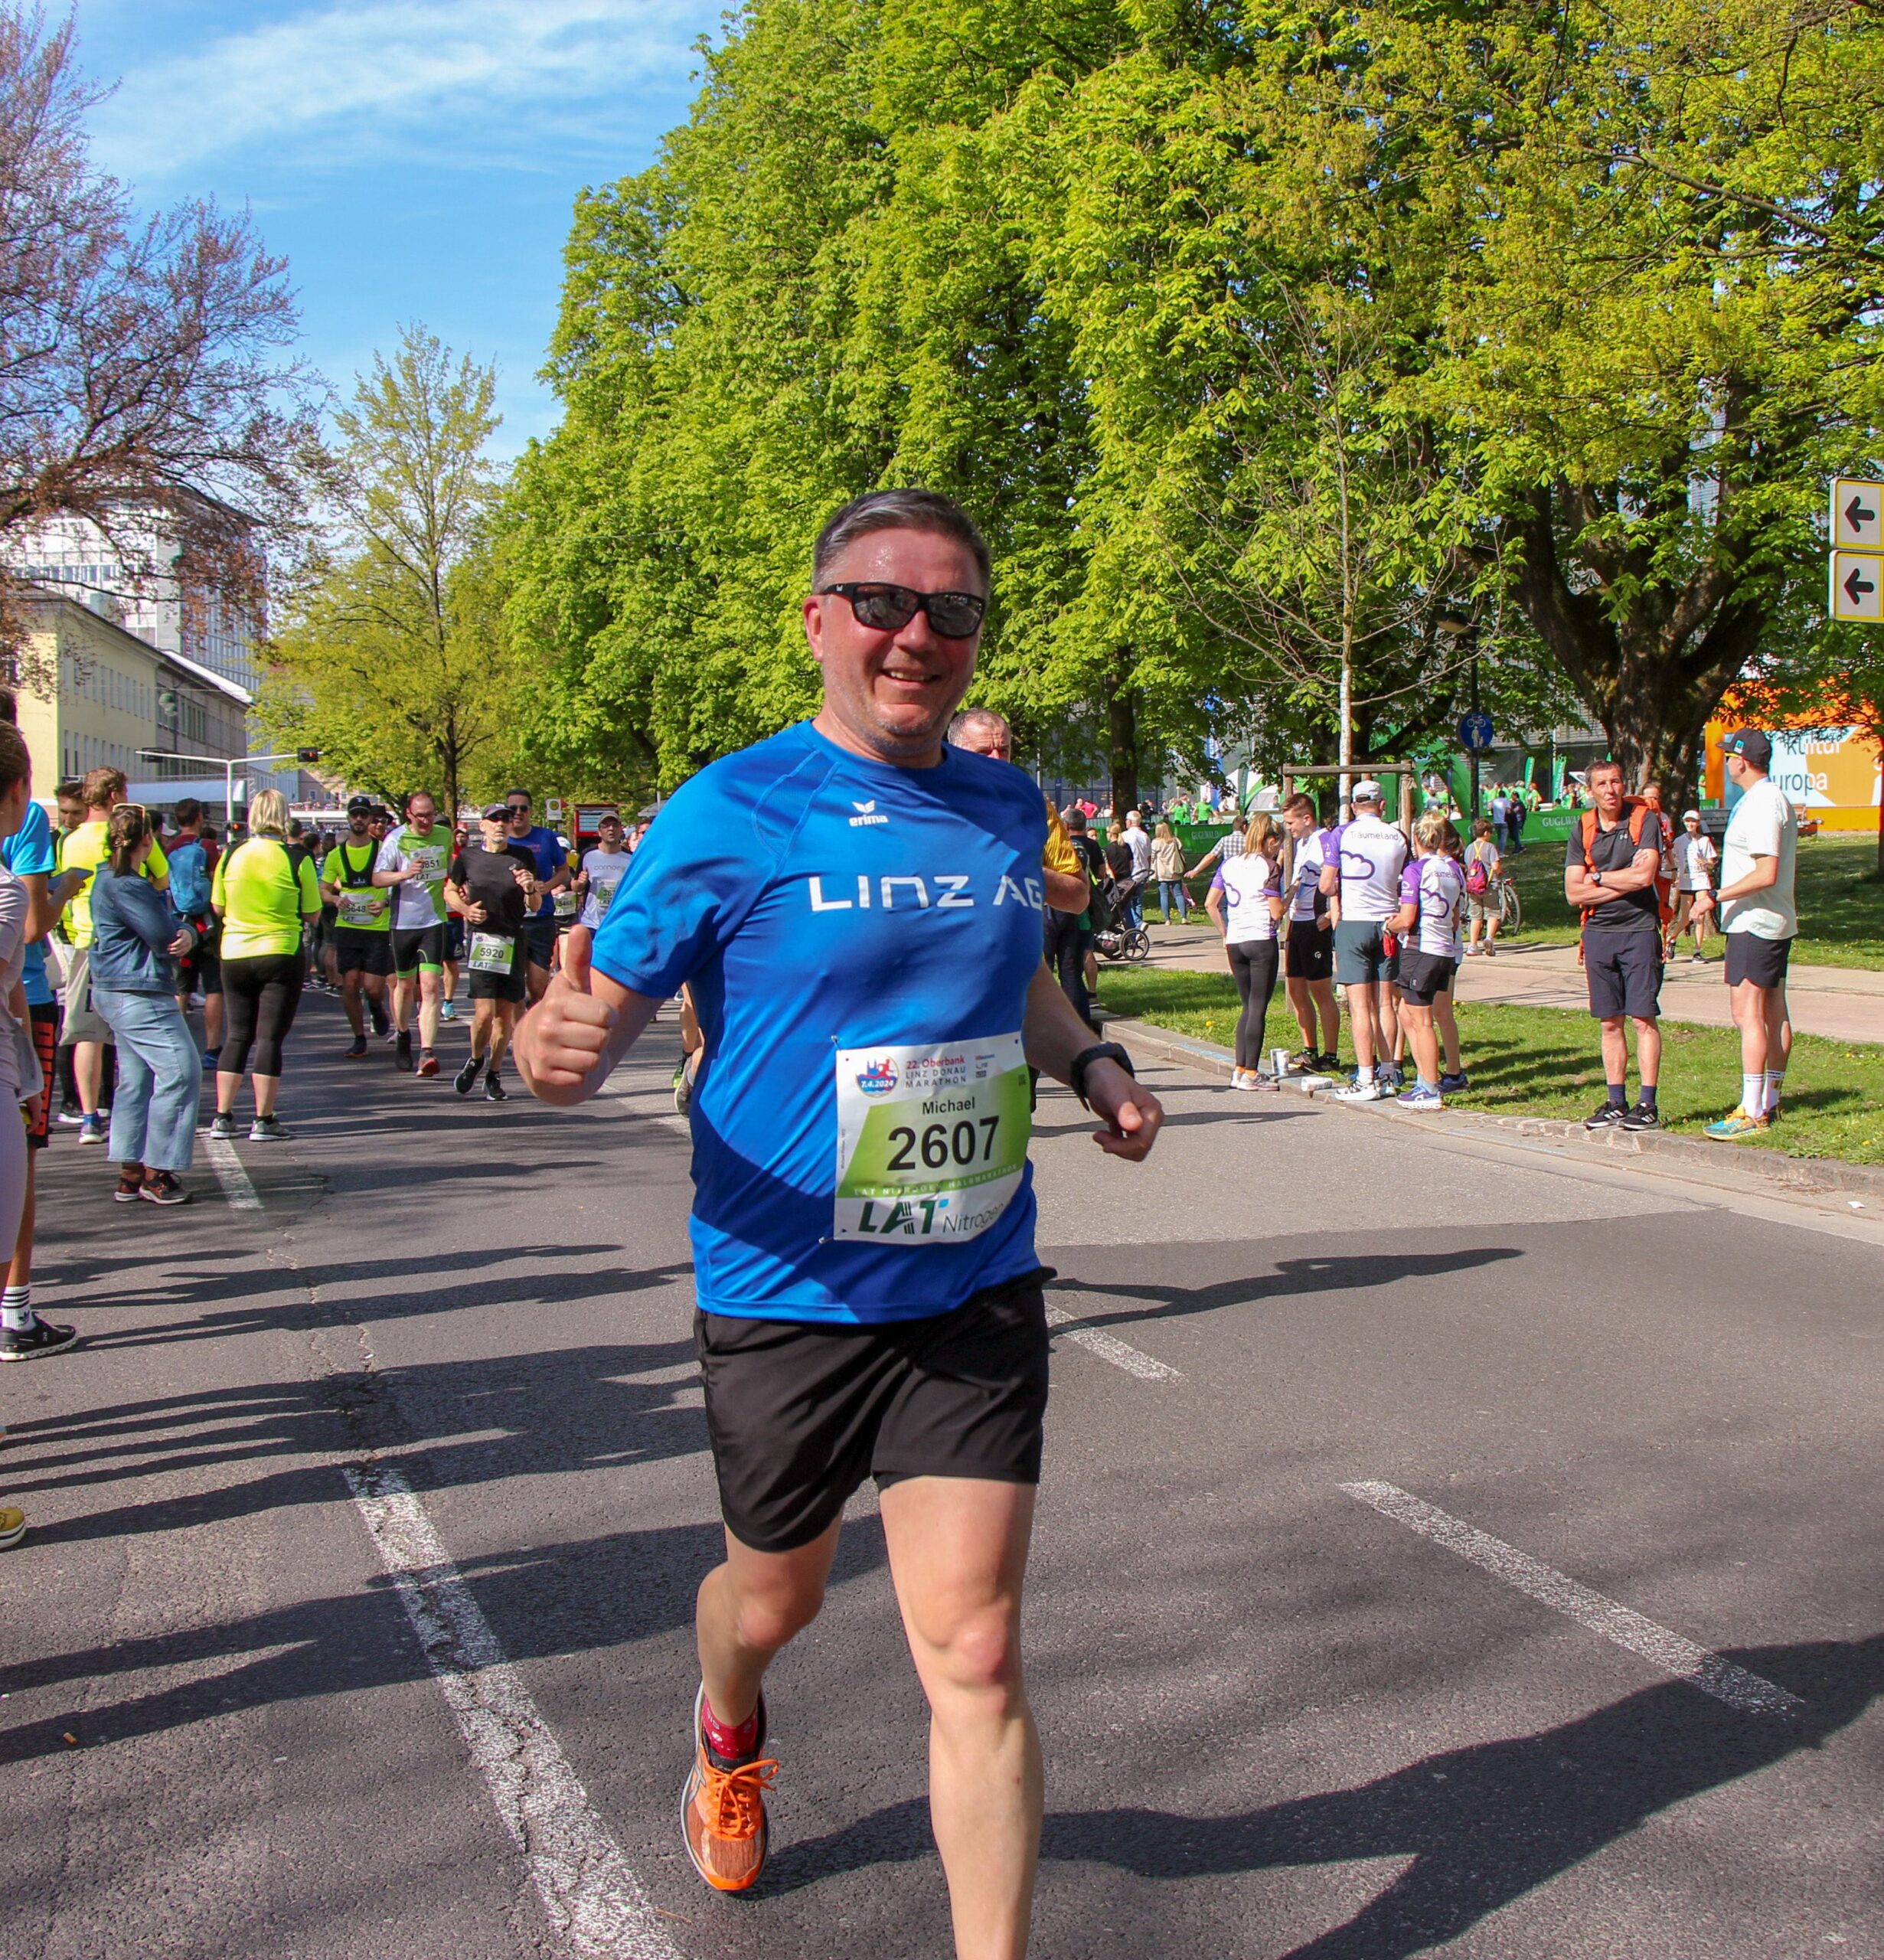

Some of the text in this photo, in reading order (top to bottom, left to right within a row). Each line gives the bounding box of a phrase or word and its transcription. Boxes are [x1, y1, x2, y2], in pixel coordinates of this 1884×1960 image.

[1773, 772, 1828, 796] uropa
[848, 813, 889, 827] erima
[1542, 815, 1580, 827] GUGLWA
[992, 874, 1043, 911] AG
[479, 947, 504, 959] 5920
[472, 960, 489, 969] LAT
[906, 1060, 919, 1070] 22.
[922, 1056, 965, 1068] Oberbank
[906, 1070, 928, 1080] LINZ
[932, 1067, 966, 1077] DONAU
[860, 1080, 894, 1088] 7.4.2024
[906, 1076, 966, 1088] MARATHON
[922, 1096, 975, 1115] Michael
[886, 1115, 1000, 1171] 2607
[858, 1199, 937, 1235] LAT
